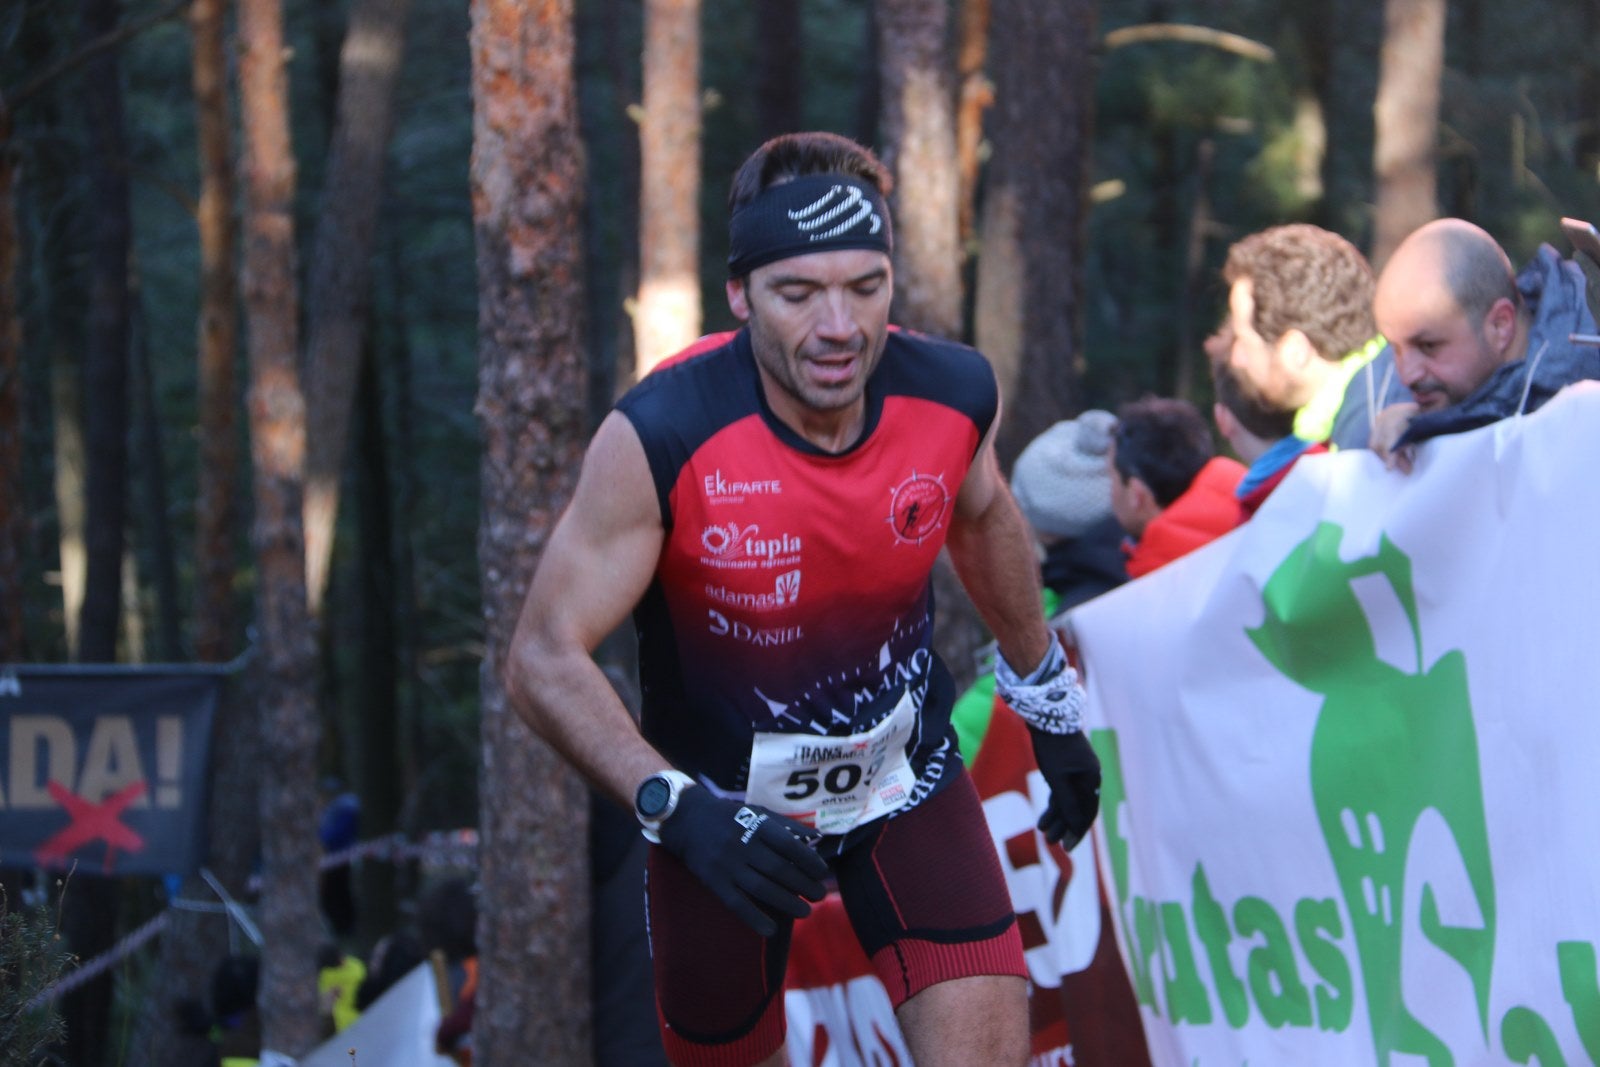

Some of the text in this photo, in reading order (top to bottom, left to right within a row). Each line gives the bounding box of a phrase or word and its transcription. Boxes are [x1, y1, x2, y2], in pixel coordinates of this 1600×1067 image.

[745, 532, 802, 559] tapia
[705, 583, 776, 608] adamas
[733, 621, 803, 648] DANIEL
[0, 714, 183, 809] DA!
